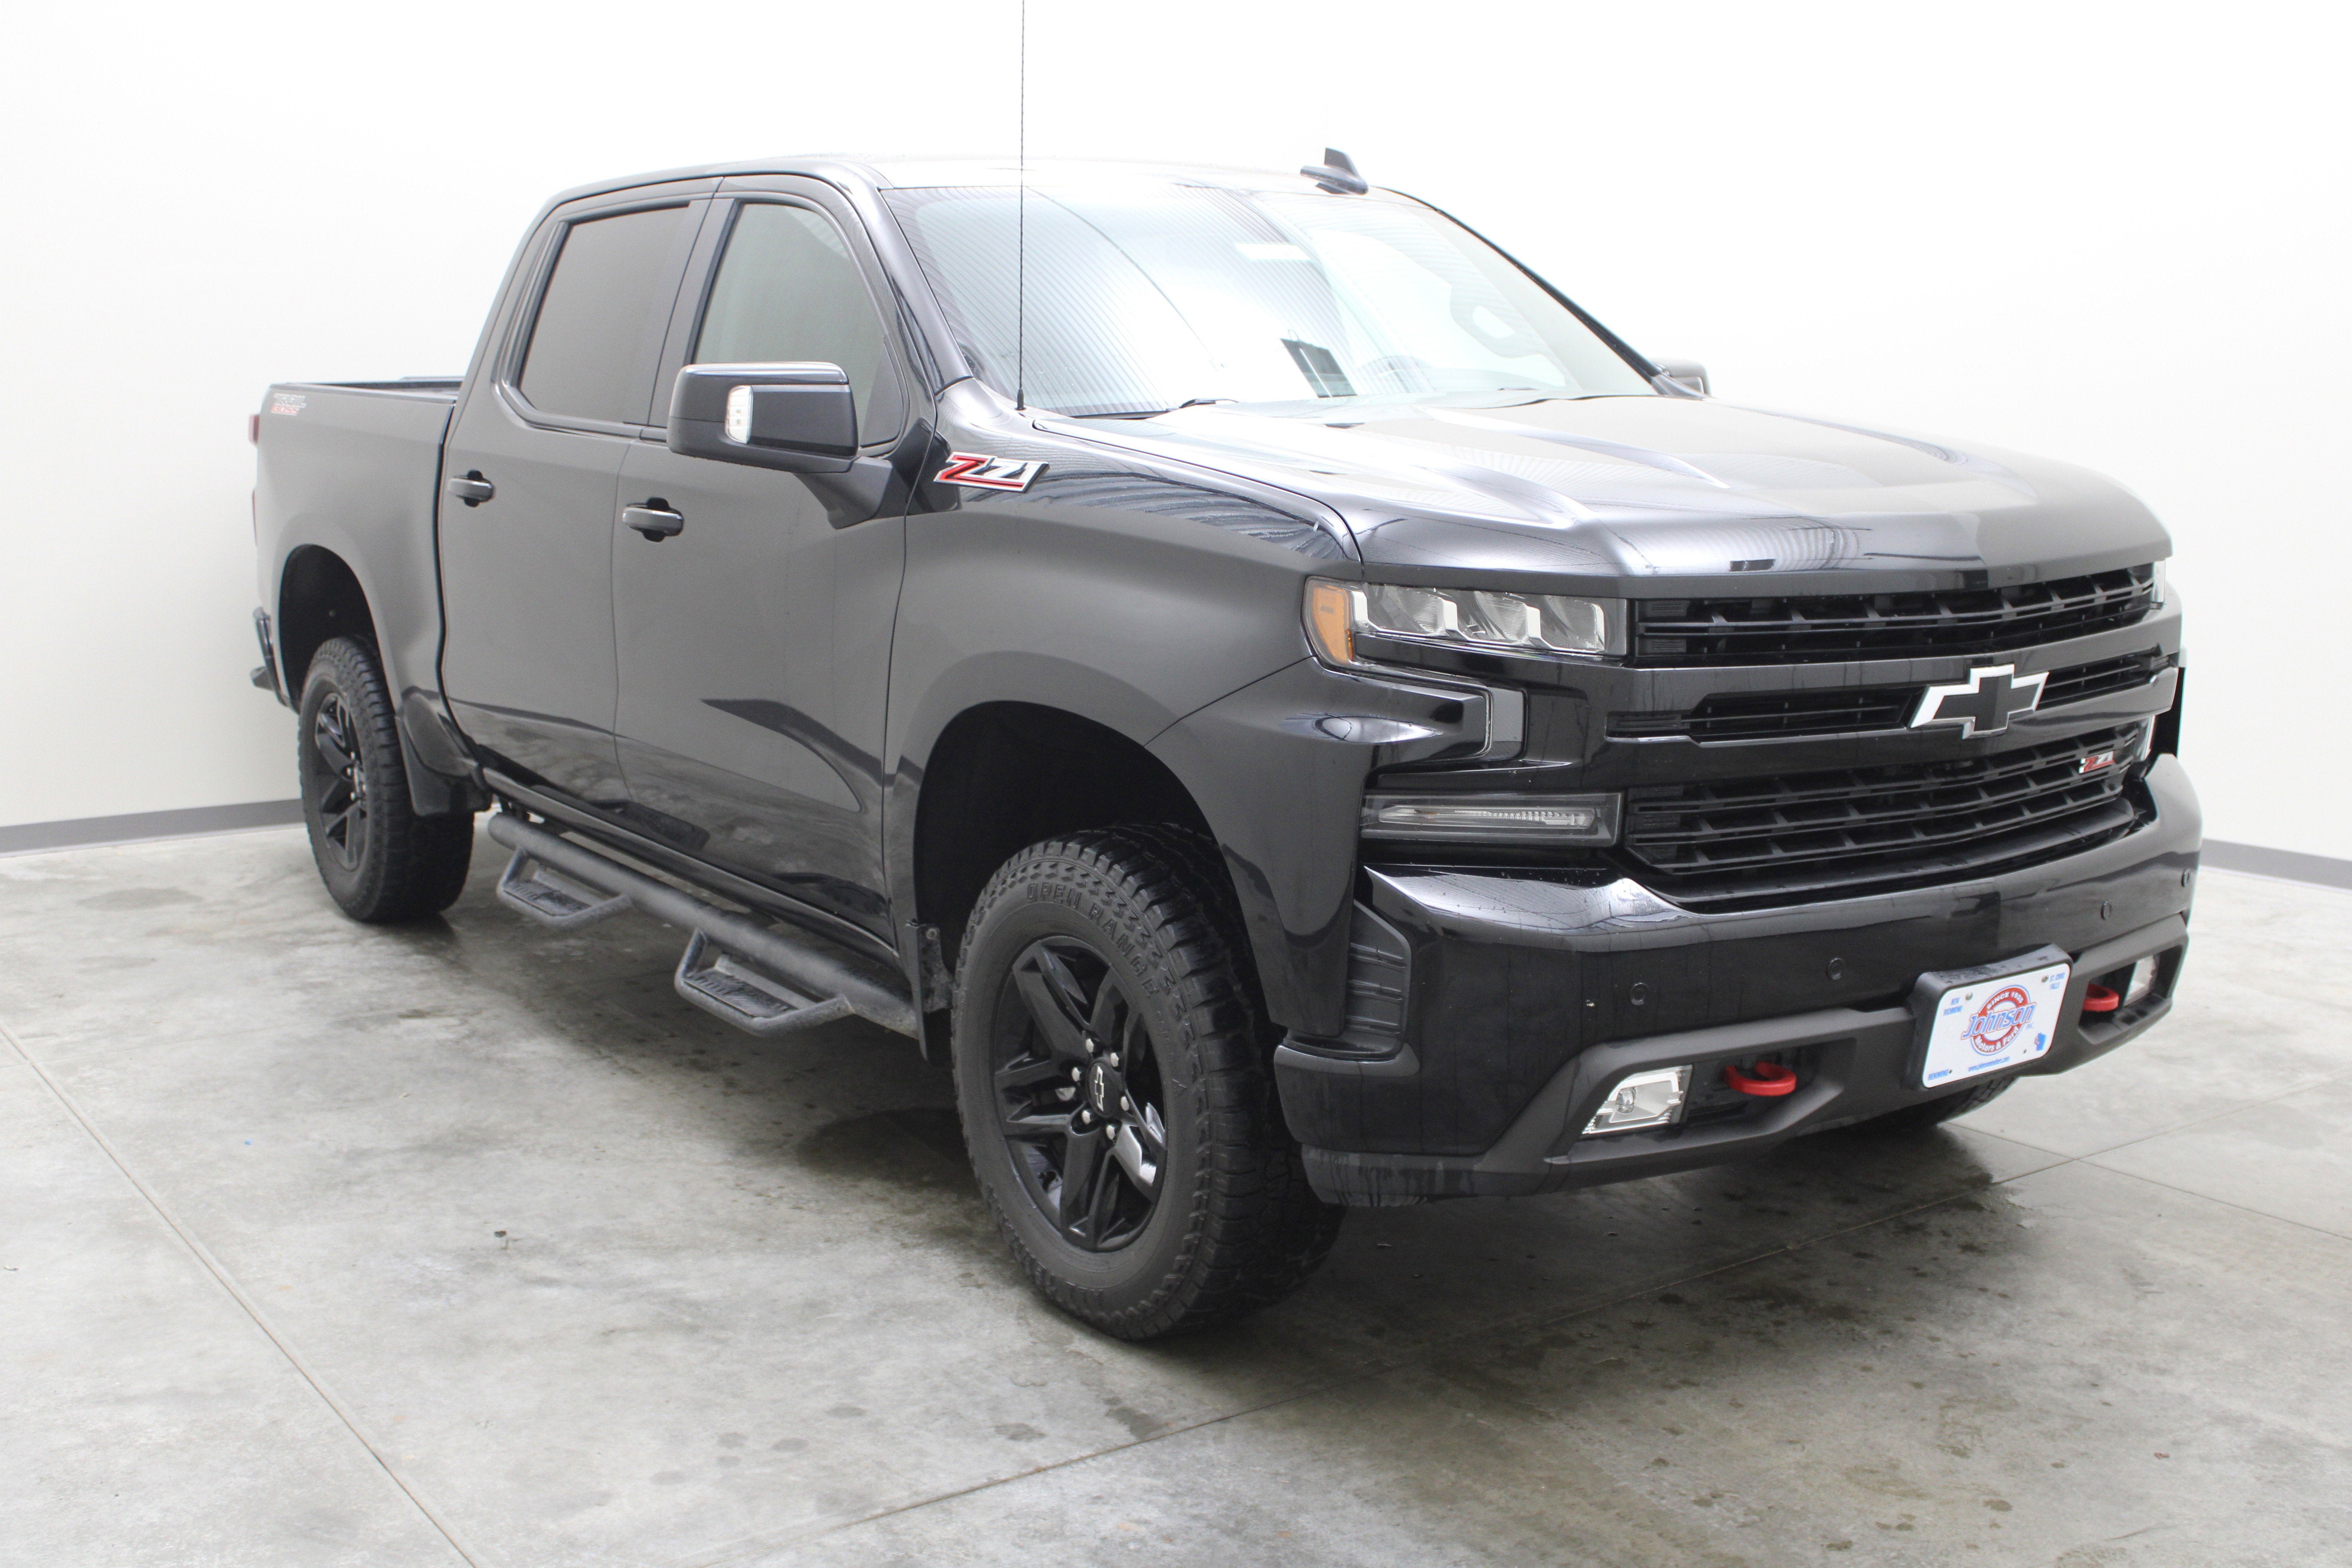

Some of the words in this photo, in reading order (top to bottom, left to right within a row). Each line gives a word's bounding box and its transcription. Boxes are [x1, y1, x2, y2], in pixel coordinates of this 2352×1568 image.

[933, 451, 1050, 492] Z71
[2078, 751, 2115, 773] Z71
[1027, 881, 1083, 910] OPEN
[1088, 903, 1160, 998] RANGE
[1987, 991, 2010, 1010] SINCE
[2011, 991, 2025, 1004] 1925
[1962, 1003, 2036, 1039] Johnson
[1975, 1035, 1996, 1052] Motors
[1996, 1041, 2002, 1051] &
[2002, 1026, 2019, 1046] Ford
